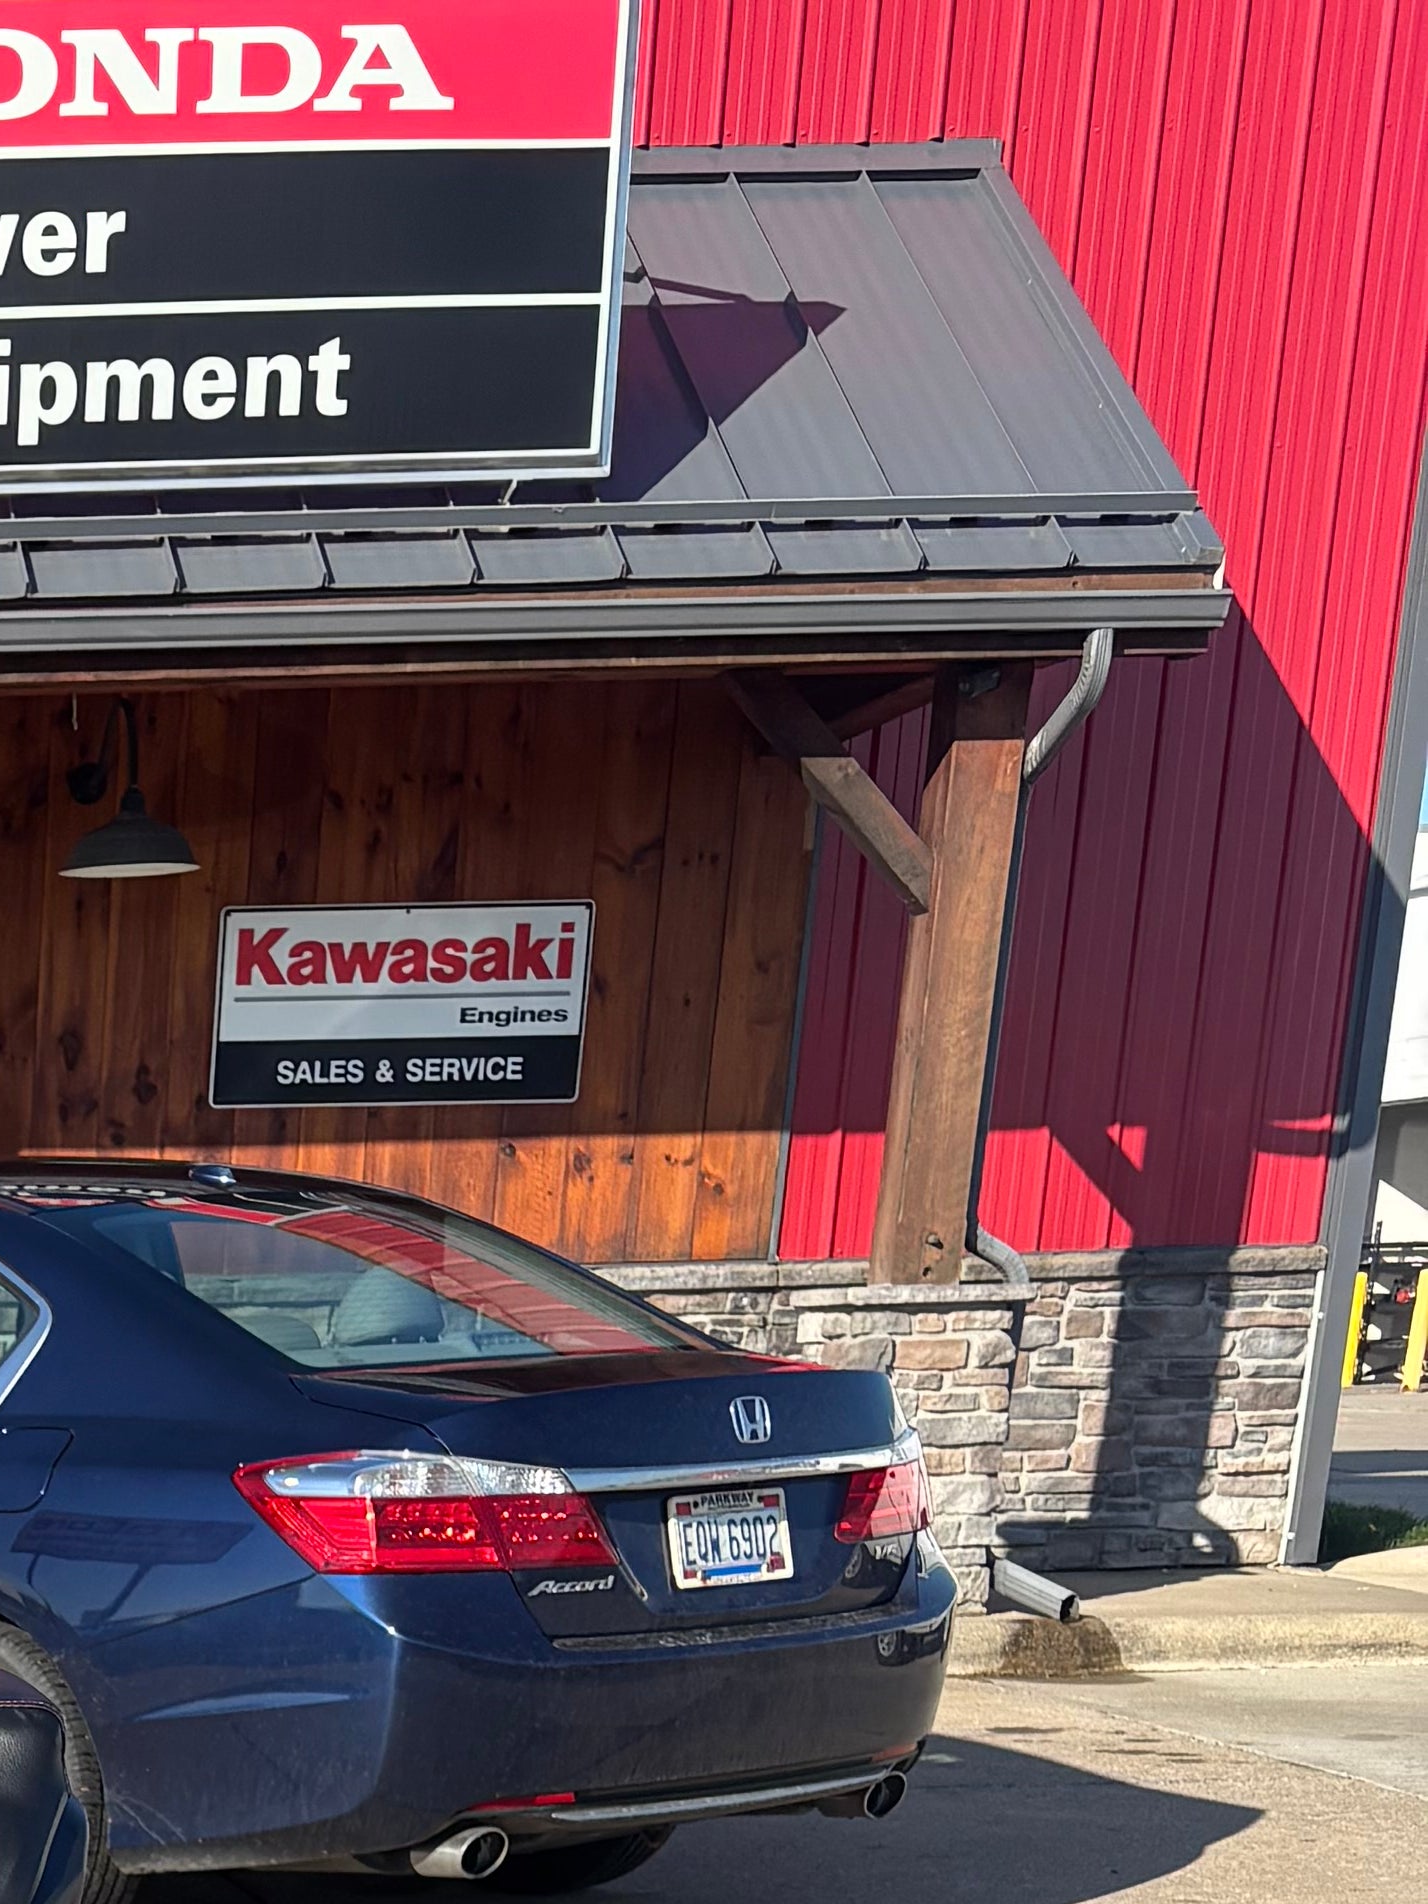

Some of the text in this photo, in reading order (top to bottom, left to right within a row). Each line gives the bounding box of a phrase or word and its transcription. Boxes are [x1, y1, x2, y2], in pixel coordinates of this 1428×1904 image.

[235, 922, 575, 986] Kawasaki
[459, 1006, 568, 1027] Engines
[276, 1056, 523, 1084] SALES & SERVICE
[700, 1491, 755, 1508] PARKWAY
[528, 1575, 615, 1597] Accord
